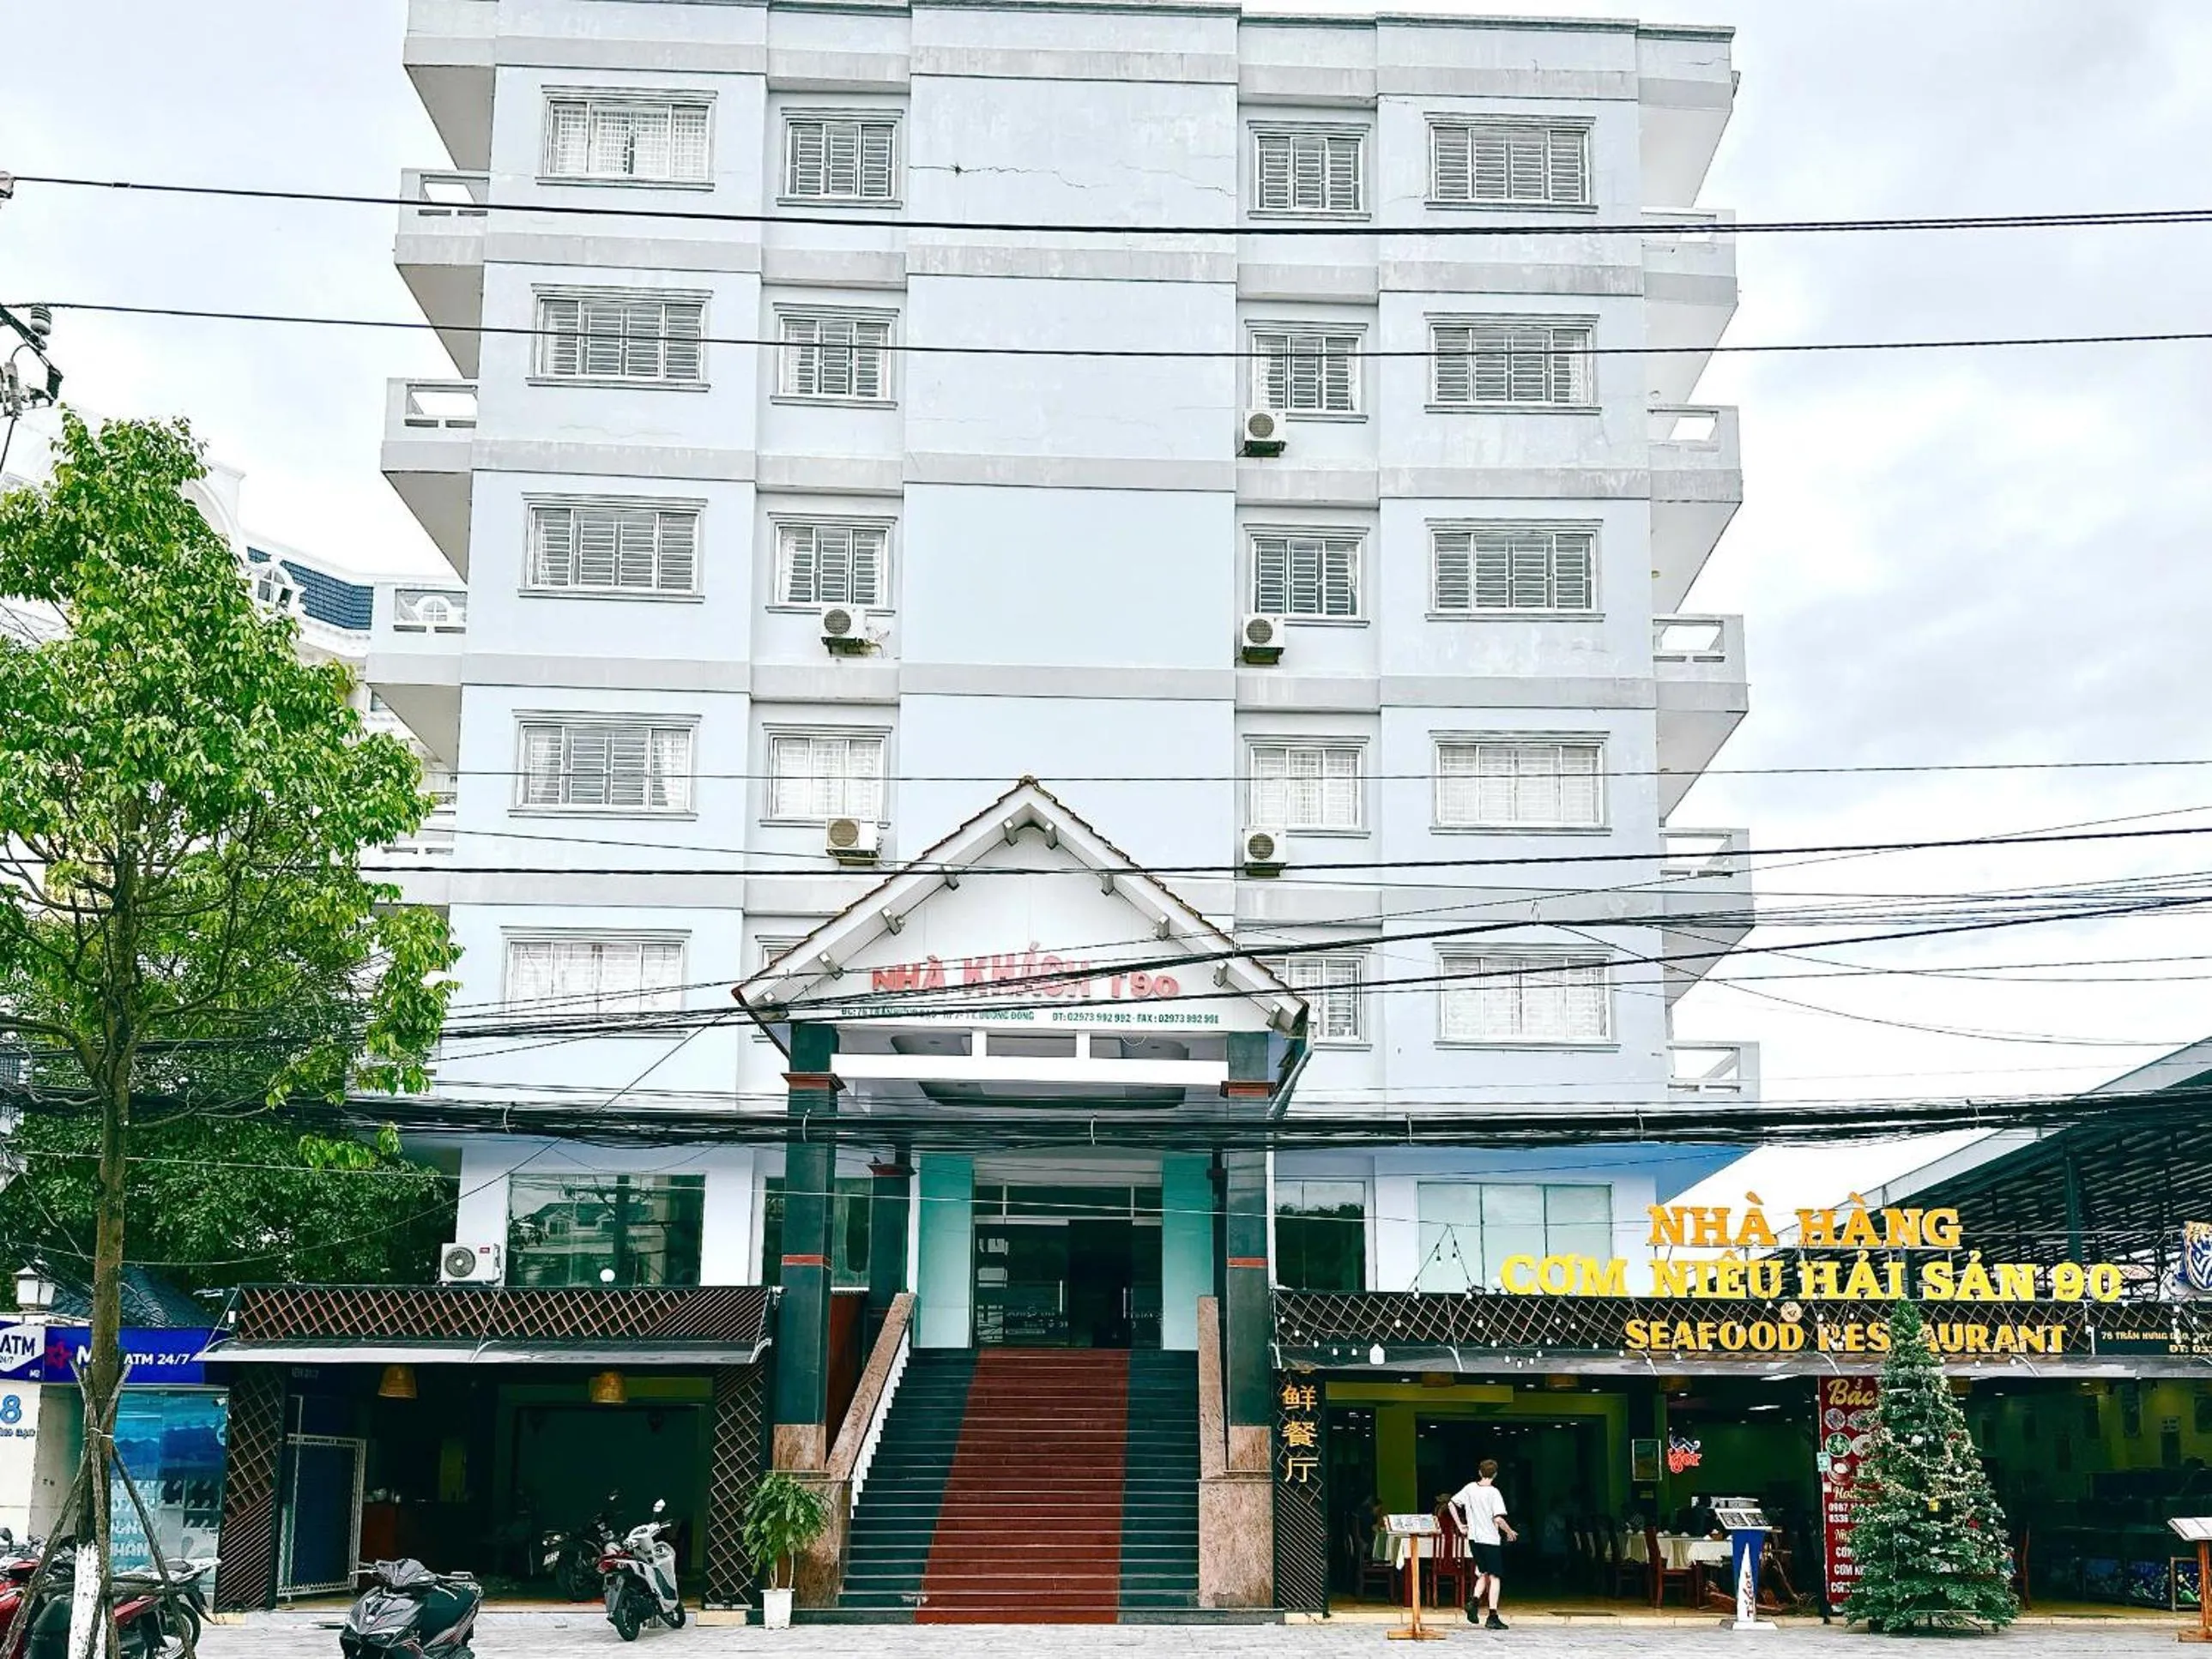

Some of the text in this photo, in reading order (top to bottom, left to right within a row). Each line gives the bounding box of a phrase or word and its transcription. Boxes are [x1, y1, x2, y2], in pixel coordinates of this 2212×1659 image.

[873, 955, 946, 991] NHÀ
[963, 941, 1091, 998] KHÁCH
[1646, 1191, 1963, 1248] NHÀ HÀNG
[1501, 1250, 2124, 1303] CƠM NIÊU HẢI SẢN 90
[0, 1335, 36, 1357] ATM
[124, 1354, 153, 1366] ATM
[157, 1353, 190, 1366] 24/7
[1625, 1319, 2067, 1353] SEAFOOD RESAURANT
[1281, 1371, 1319, 1483] 鲜餐厅
